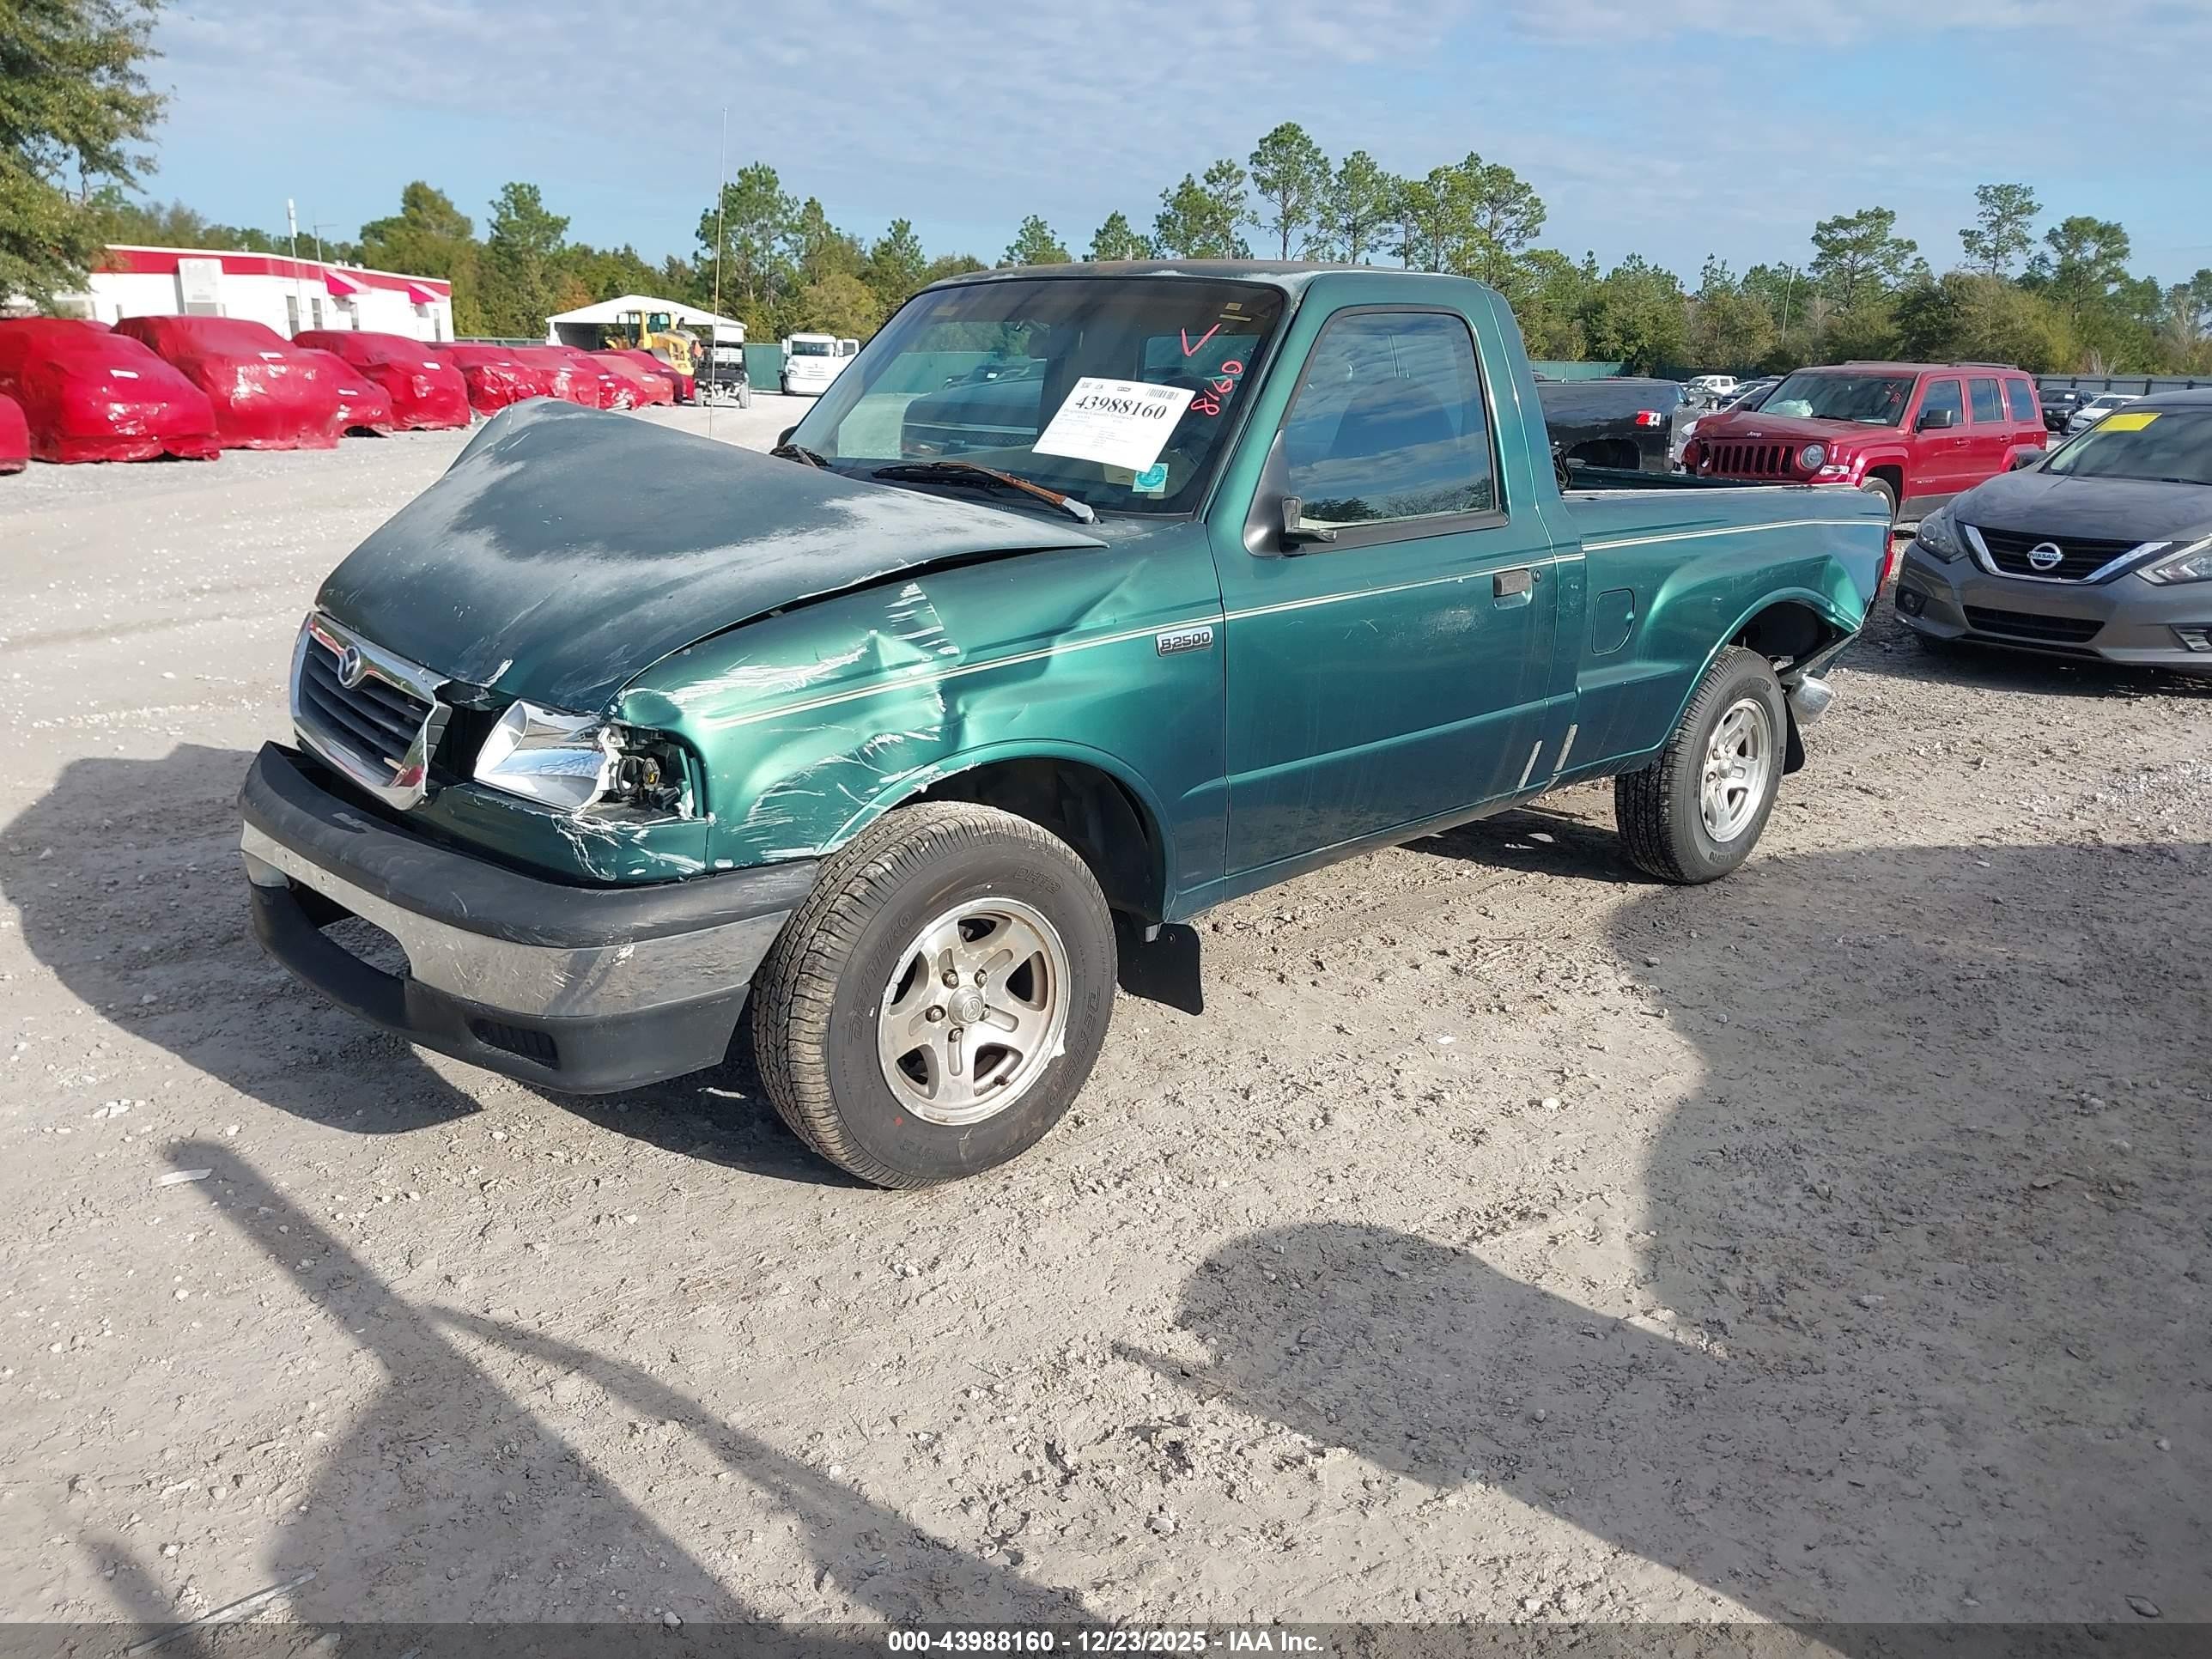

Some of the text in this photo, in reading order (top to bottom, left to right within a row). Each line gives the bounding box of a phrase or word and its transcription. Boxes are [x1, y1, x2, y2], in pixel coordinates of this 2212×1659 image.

[1075, 395, 1167, 420] 43988160
[2028, 551, 2061, 560] NISSAN
[1160, 631, 1210, 650] B2500
